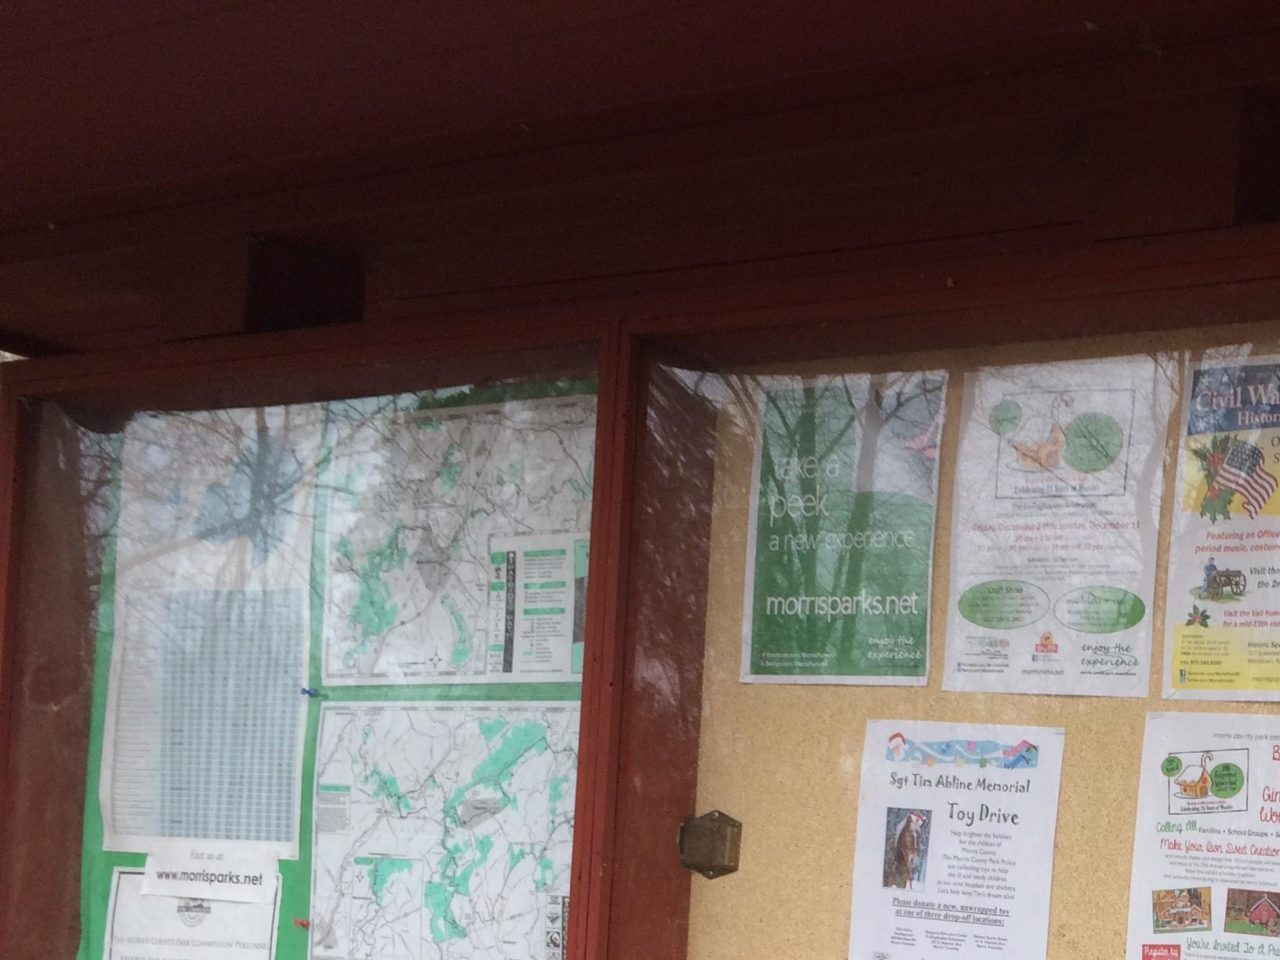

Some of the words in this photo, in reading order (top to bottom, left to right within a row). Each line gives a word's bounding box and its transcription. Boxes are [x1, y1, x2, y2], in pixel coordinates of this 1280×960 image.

[1196, 387, 1242, 412] Civil
[770, 485, 829, 527] peek
[769, 535, 779, 551] a
[784, 536, 818, 551] new
[825, 530, 915, 549] experience
[1206, 532, 1244, 541] Featuring
[1246, 531, 1255, 539] an
[1195, 544, 1221, 554] period
[1250, 567, 1266, 575] Visit
[1268, 567, 1280, 575] the
[1257, 580, 1270, 589] the
[767, 588, 918, 622] morrisparks.net
[890, 772, 908, 789] Sgt
[912, 773, 932, 787] Tim
[935, 776, 972, 790] Abline
[975, 778, 1030, 793] Memorial
[947, 801, 975, 826] Toy
[980, 803, 1019, 825] Drive
[1160, 839, 1182, 851] Make
[156, 869, 263, 886] www.morrisparks.net
